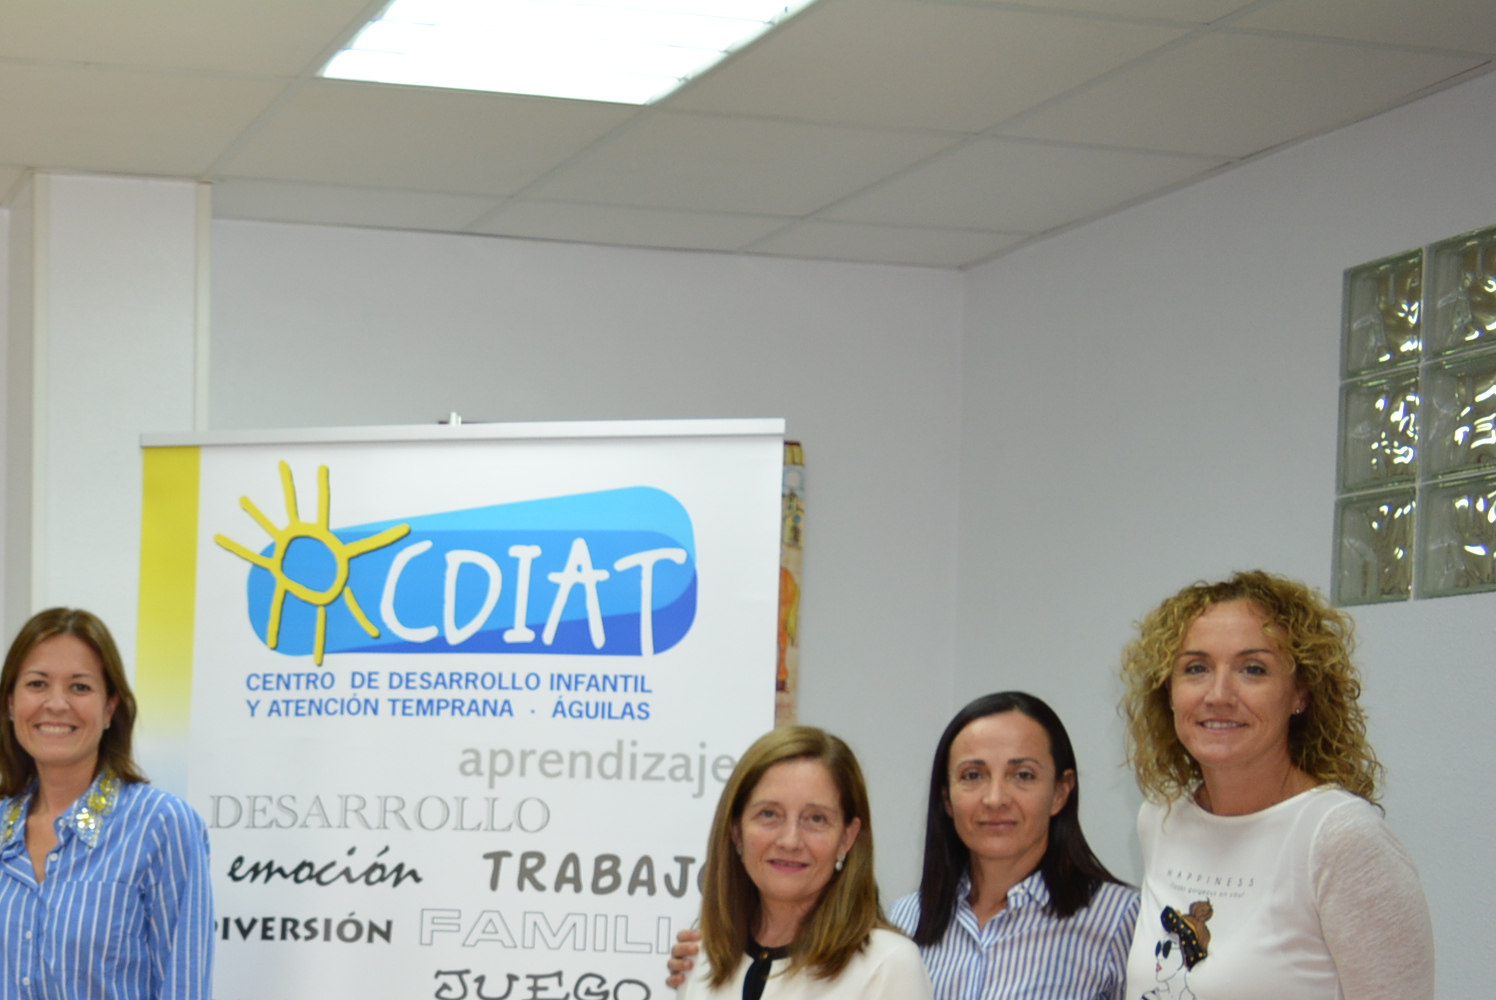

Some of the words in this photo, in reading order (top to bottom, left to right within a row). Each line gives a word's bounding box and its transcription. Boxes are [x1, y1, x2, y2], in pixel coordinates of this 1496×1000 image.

[379, 537, 688, 656] CDIAT
[245, 671, 335, 692] CENTRO
[350, 671, 380, 690] DE
[388, 671, 541, 692] DESARROLLO
[549, 673, 653, 694] INFANTIL
[246, 699, 261, 717] Y
[267, 693, 379, 717] ATENCIÓN
[388, 698, 514, 717] TEMPRANA
[552, 695, 651, 720] ÁGUILAS
[458, 739, 736, 798] aprendizaje
[209, 794, 551, 834] DESARROLLO
[227, 845, 423, 888] emoción
[482, 850, 705, 898] TRABAJ
[1167, 869, 1254, 887] HAPPINESS
[214, 912, 393, 944] IVERSIÓN
[419, 908, 699, 955] FAMILI
